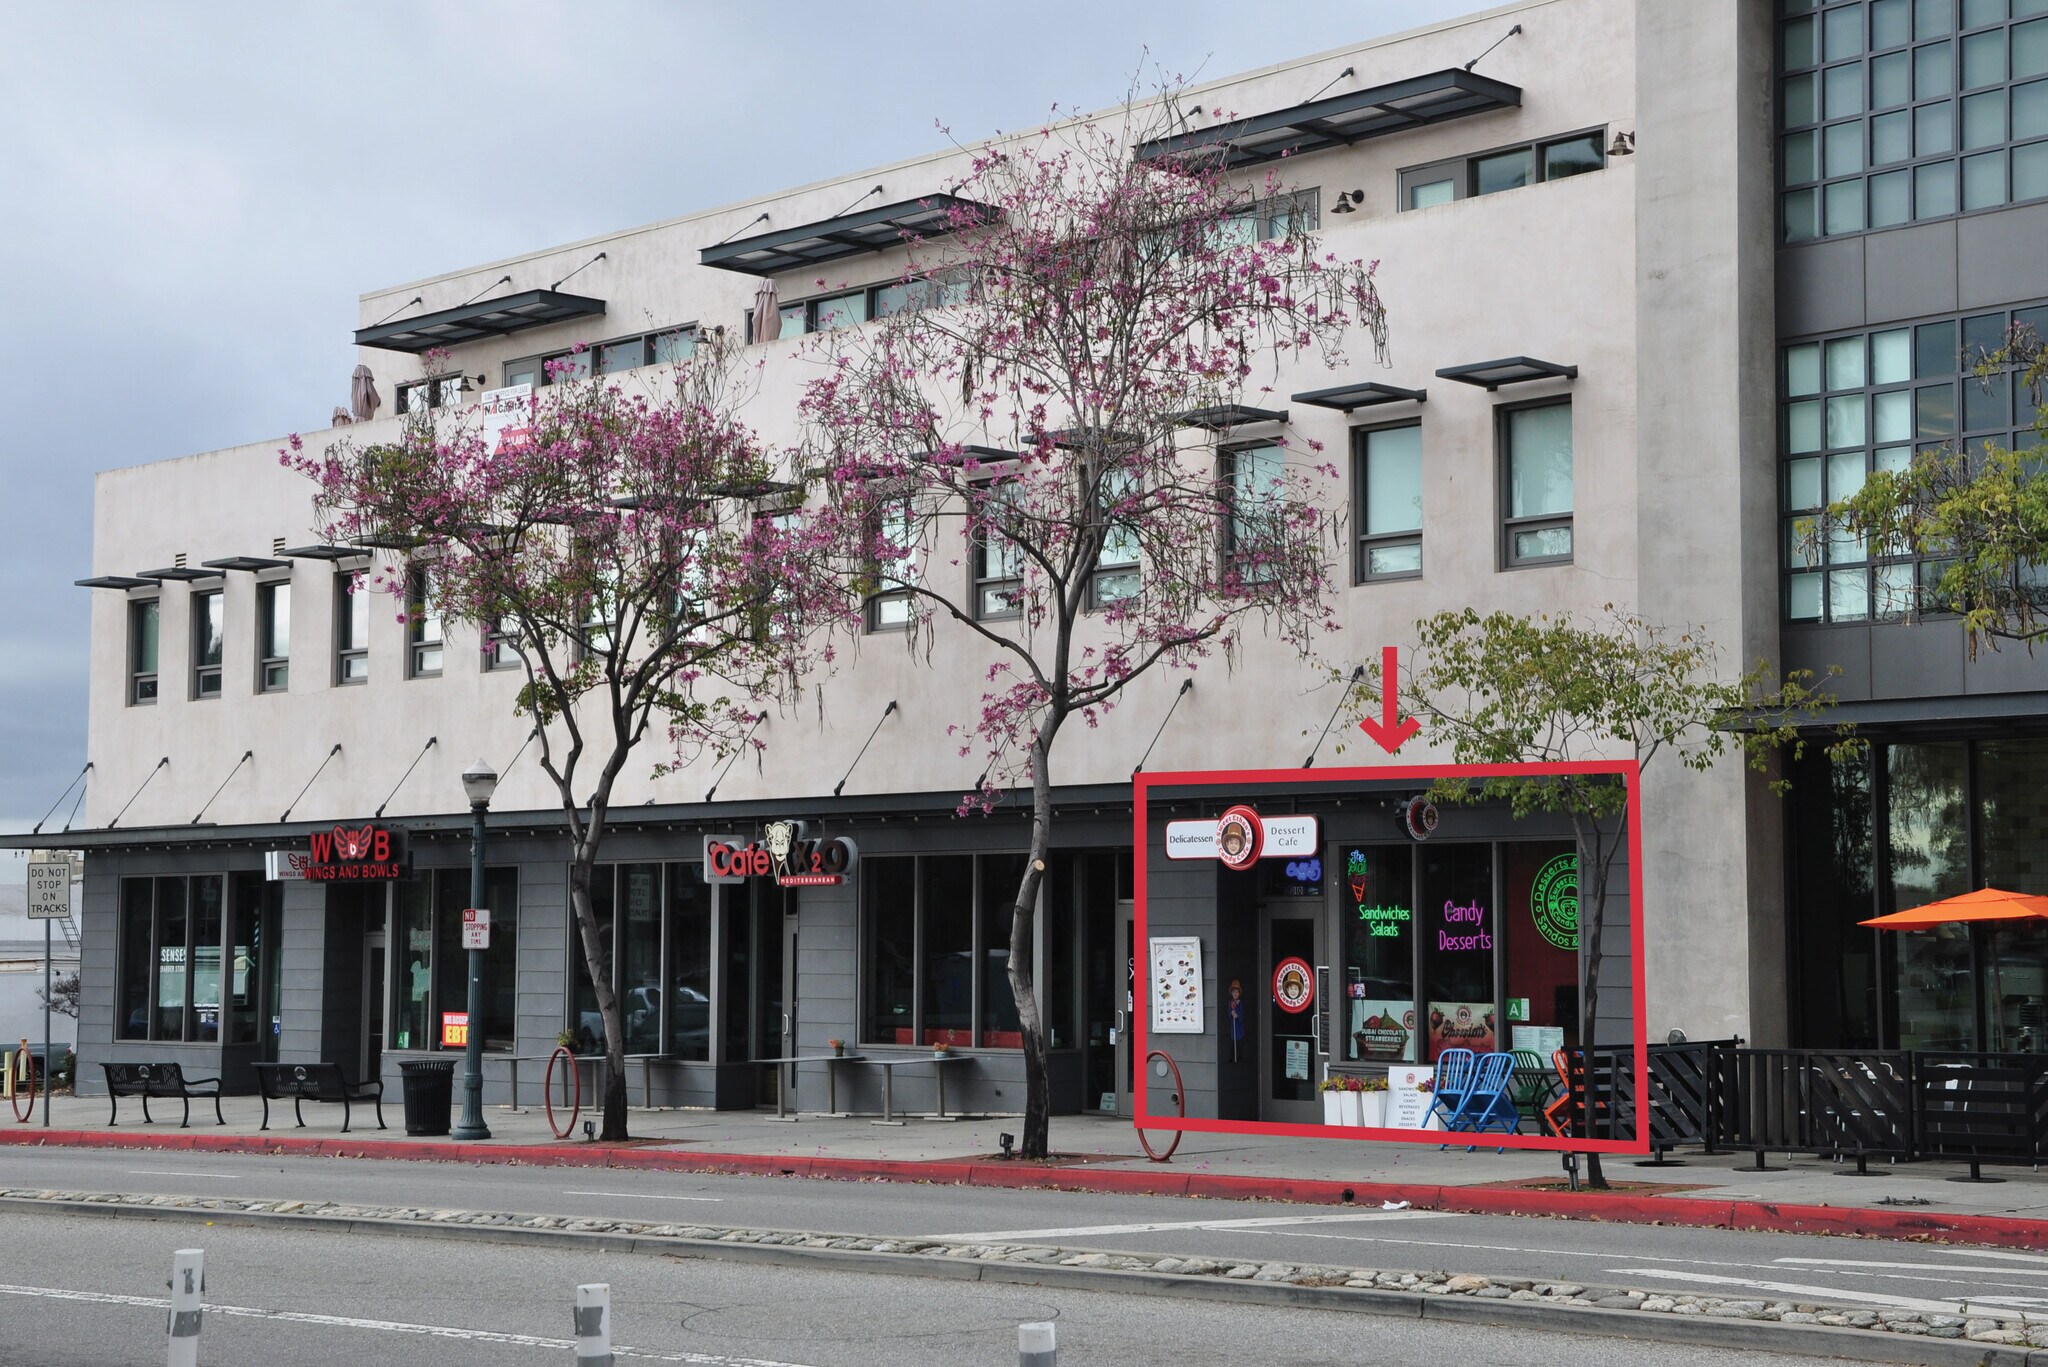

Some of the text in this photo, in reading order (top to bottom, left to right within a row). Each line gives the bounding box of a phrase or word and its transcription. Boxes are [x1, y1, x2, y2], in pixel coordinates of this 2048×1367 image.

[499, 433, 530, 449] AAILABLE
[1217, 815, 1250, 837] Sweet Ethan's
[1271, 826, 1305, 835] Dessert
[1169, 834, 1214, 844] Delicatessen
[1278, 837, 1298, 846] Cafe
[311, 832, 332, 863] W
[374, 830, 390, 861] B
[1219, 846, 1250, 863] Candy Cafe
[1350, 850, 1365, 864] The
[31, 868, 67, 877] DO NOT
[303, 864, 399, 879] WINGS AND BOWLS
[37, 880, 61, 889] STOP
[780, 876, 835, 884] MEDITERRANEAN
[1534, 859, 1569, 902] Desserts
[42, 892, 56, 901] ON
[31, 904, 68, 913] TRACKS
[1359, 904, 1410, 921] Sandwiches
[1444, 899, 1484, 926] Candy
[464, 911, 475, 921] NO
[465, 923, 488, 931] STOPPING
[1370, 921, 1399, 937] Salads
[1538, 916, 1570, 947] Sandos
[1438, 928, 1492, 951] Desserts
[1277, 964, 1307, 983] Sweet Ethan's
[1280, 991, 1308, 1007] Candy Cafe
[1509, 1003, 1519, 1016] A
[453, 1015, 468, 1024] ACCEP
[398, 1035, 404, 1045] A
[445, 1025, 468, 1043] EBT
[1365, 1035, 1402, 1043] STRAWBERRIES
